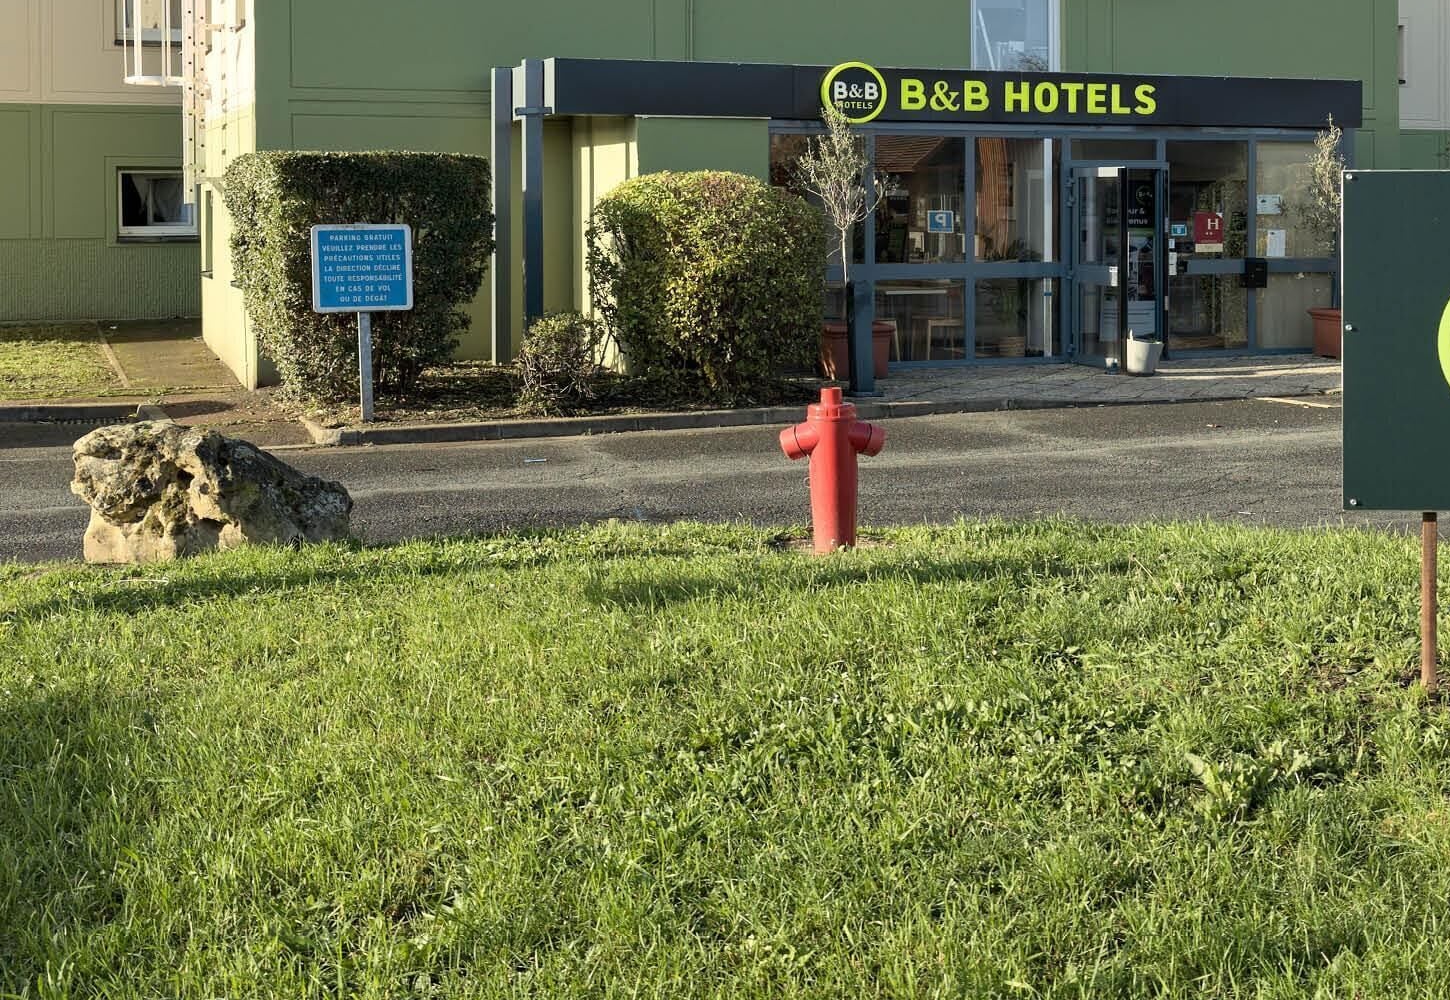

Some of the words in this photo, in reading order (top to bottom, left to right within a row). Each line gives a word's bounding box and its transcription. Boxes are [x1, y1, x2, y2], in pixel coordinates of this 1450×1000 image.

[834, 80, 879, 101] B&B
[900, 78, 990, 112] B&B
[1004, 81, 1157, 115] HOTELS
[1207, 218, 1219, 230] H
[323, 254, 374, 262] PRÉCAUTIONS
[323, 275, 345, 283] TOUTE
[378, 284, 391, 292] VOL
